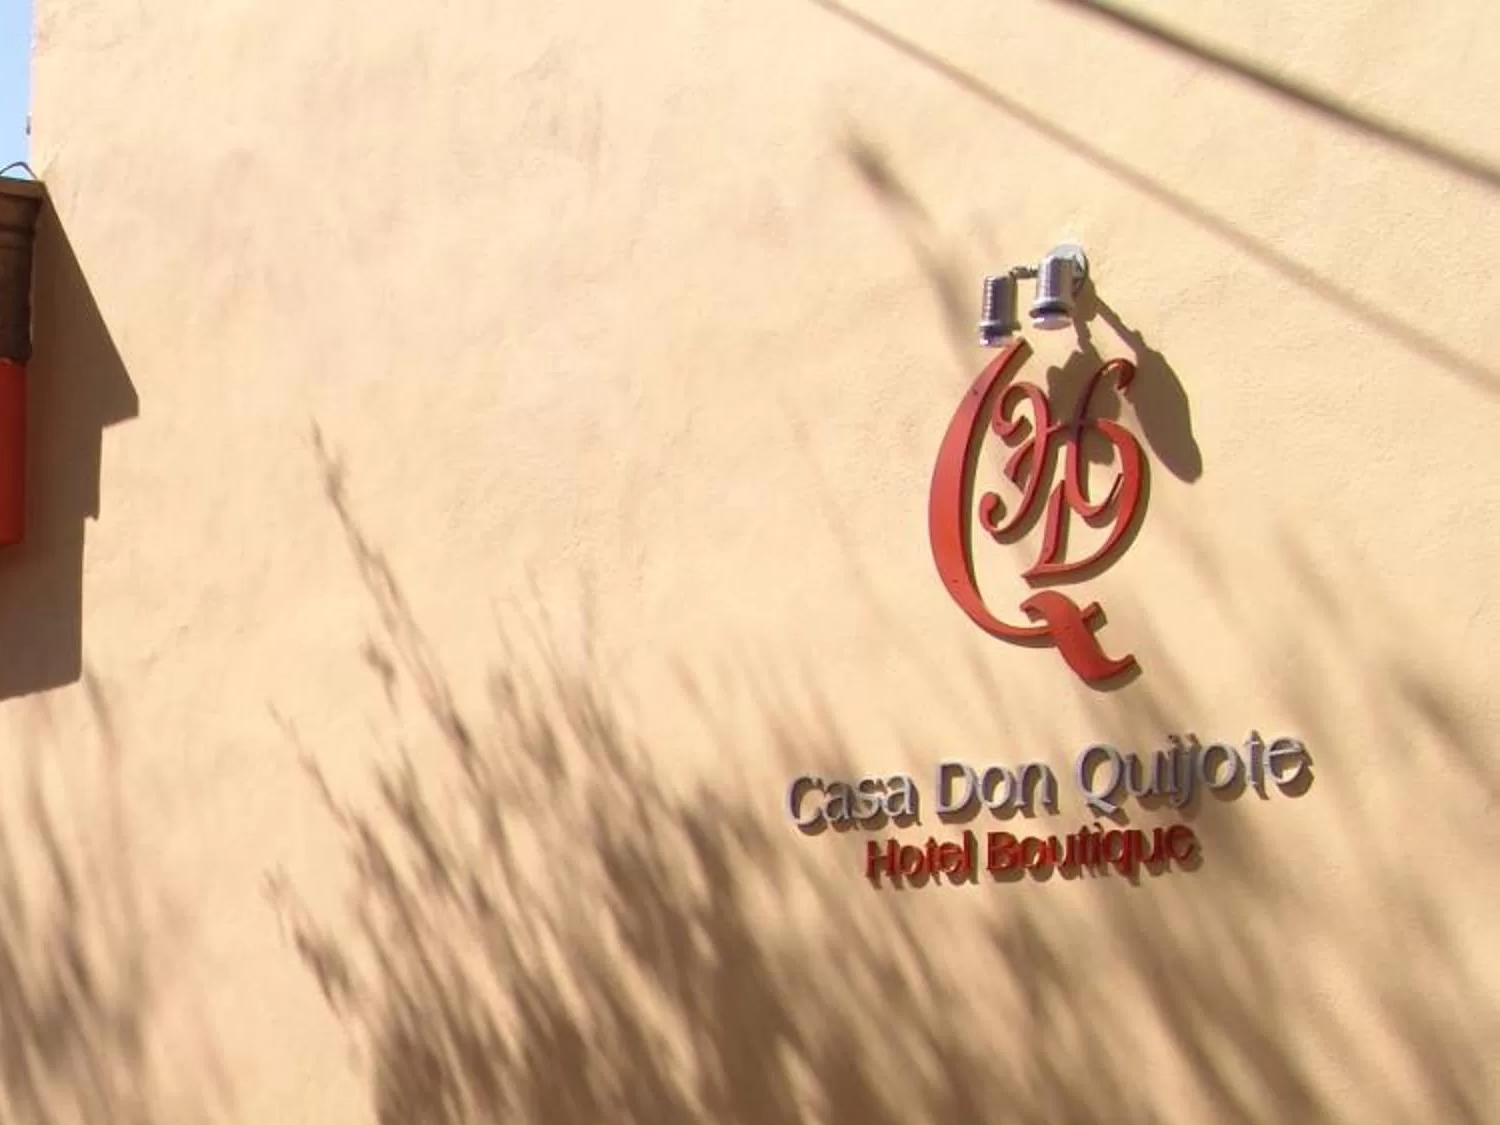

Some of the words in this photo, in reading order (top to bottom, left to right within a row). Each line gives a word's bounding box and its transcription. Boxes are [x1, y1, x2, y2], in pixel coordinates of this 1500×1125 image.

[786, 772, 917, 826] Casa
[936, 760, 1053, 814] Don
[1076, 730, 1308, 814] Quijote
[866, 830, 973, 878] Hotel
[987, 822, 1196, 873] Boutique
